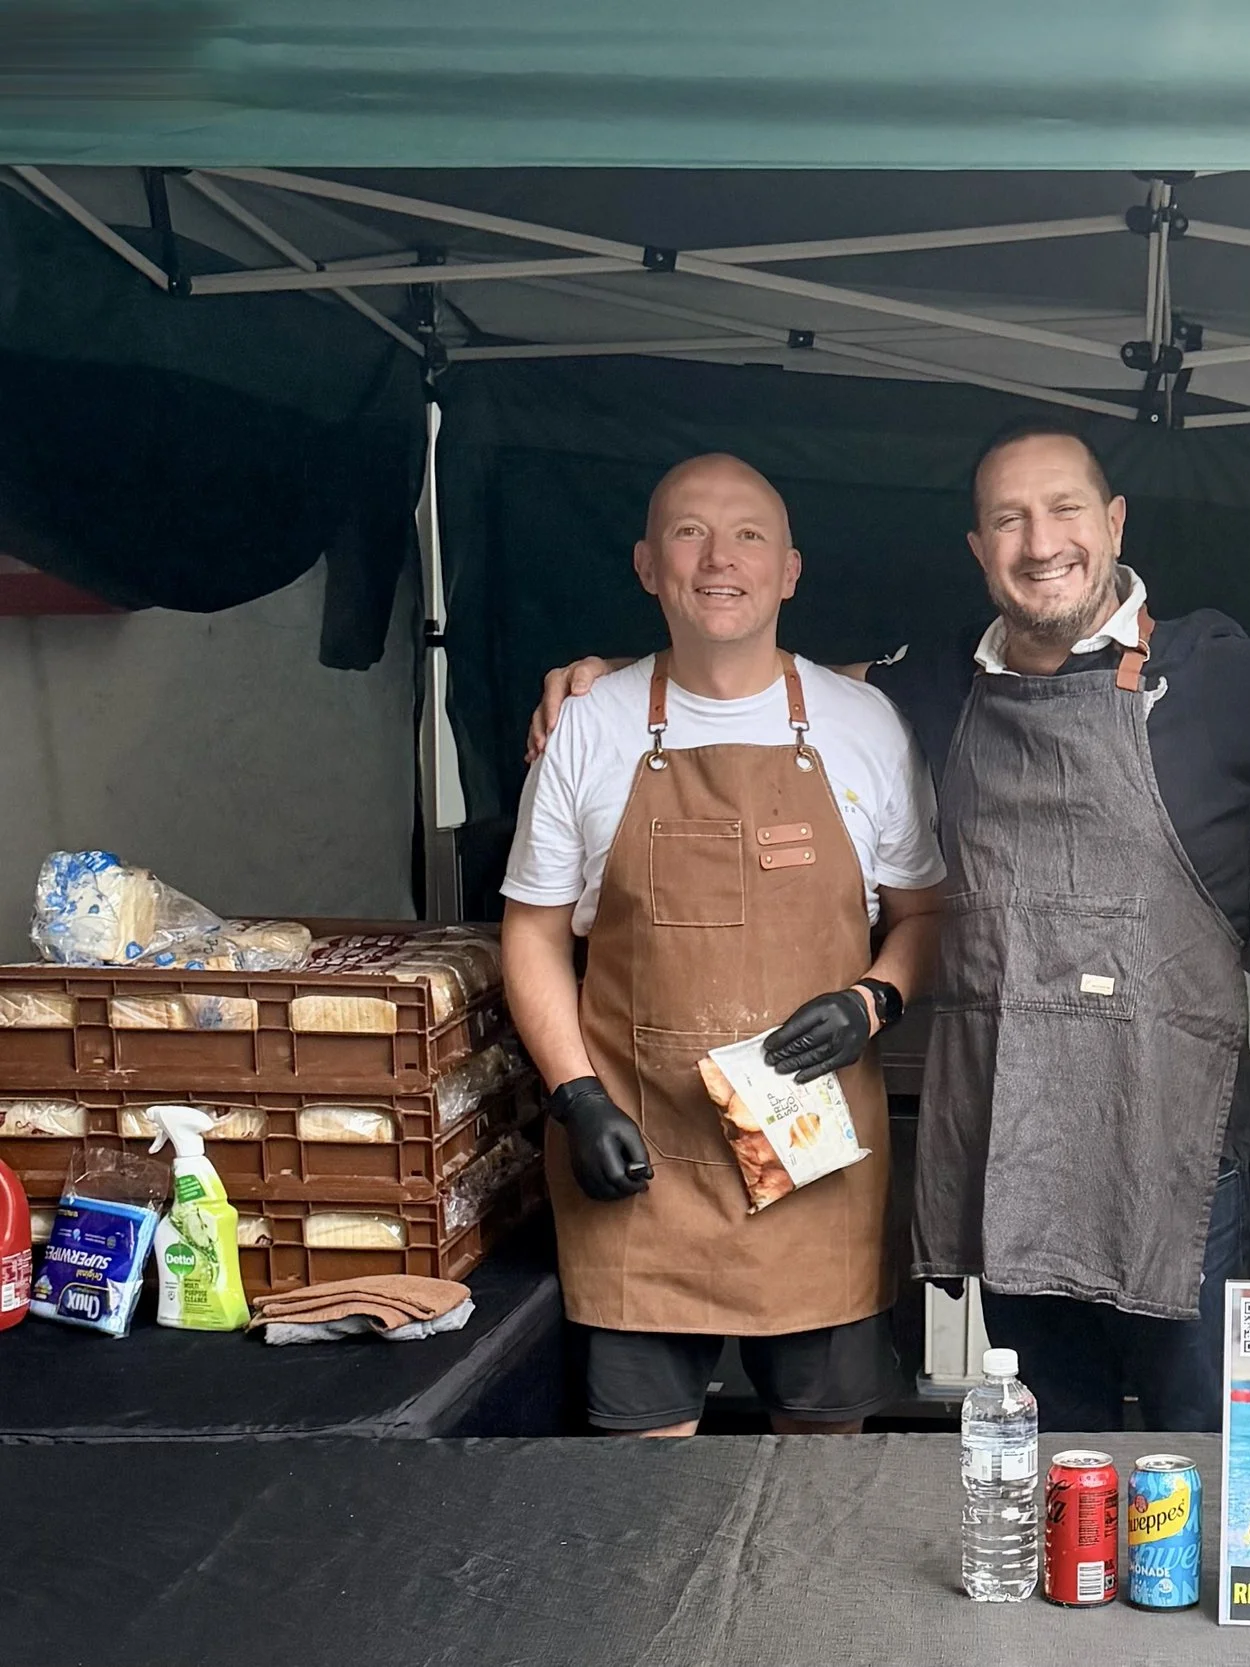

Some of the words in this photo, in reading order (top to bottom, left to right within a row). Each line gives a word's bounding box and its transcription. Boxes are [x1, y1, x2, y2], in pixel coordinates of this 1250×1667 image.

[166, 1253, 194, 1265] Dettol
[76, 1269, 103, 1281] Original
[67, 1290, 100, 1319] Chux
[1130, 1500, 1185, 1534] weppes
[1130, 1563, 1171, 1578] ONADE
